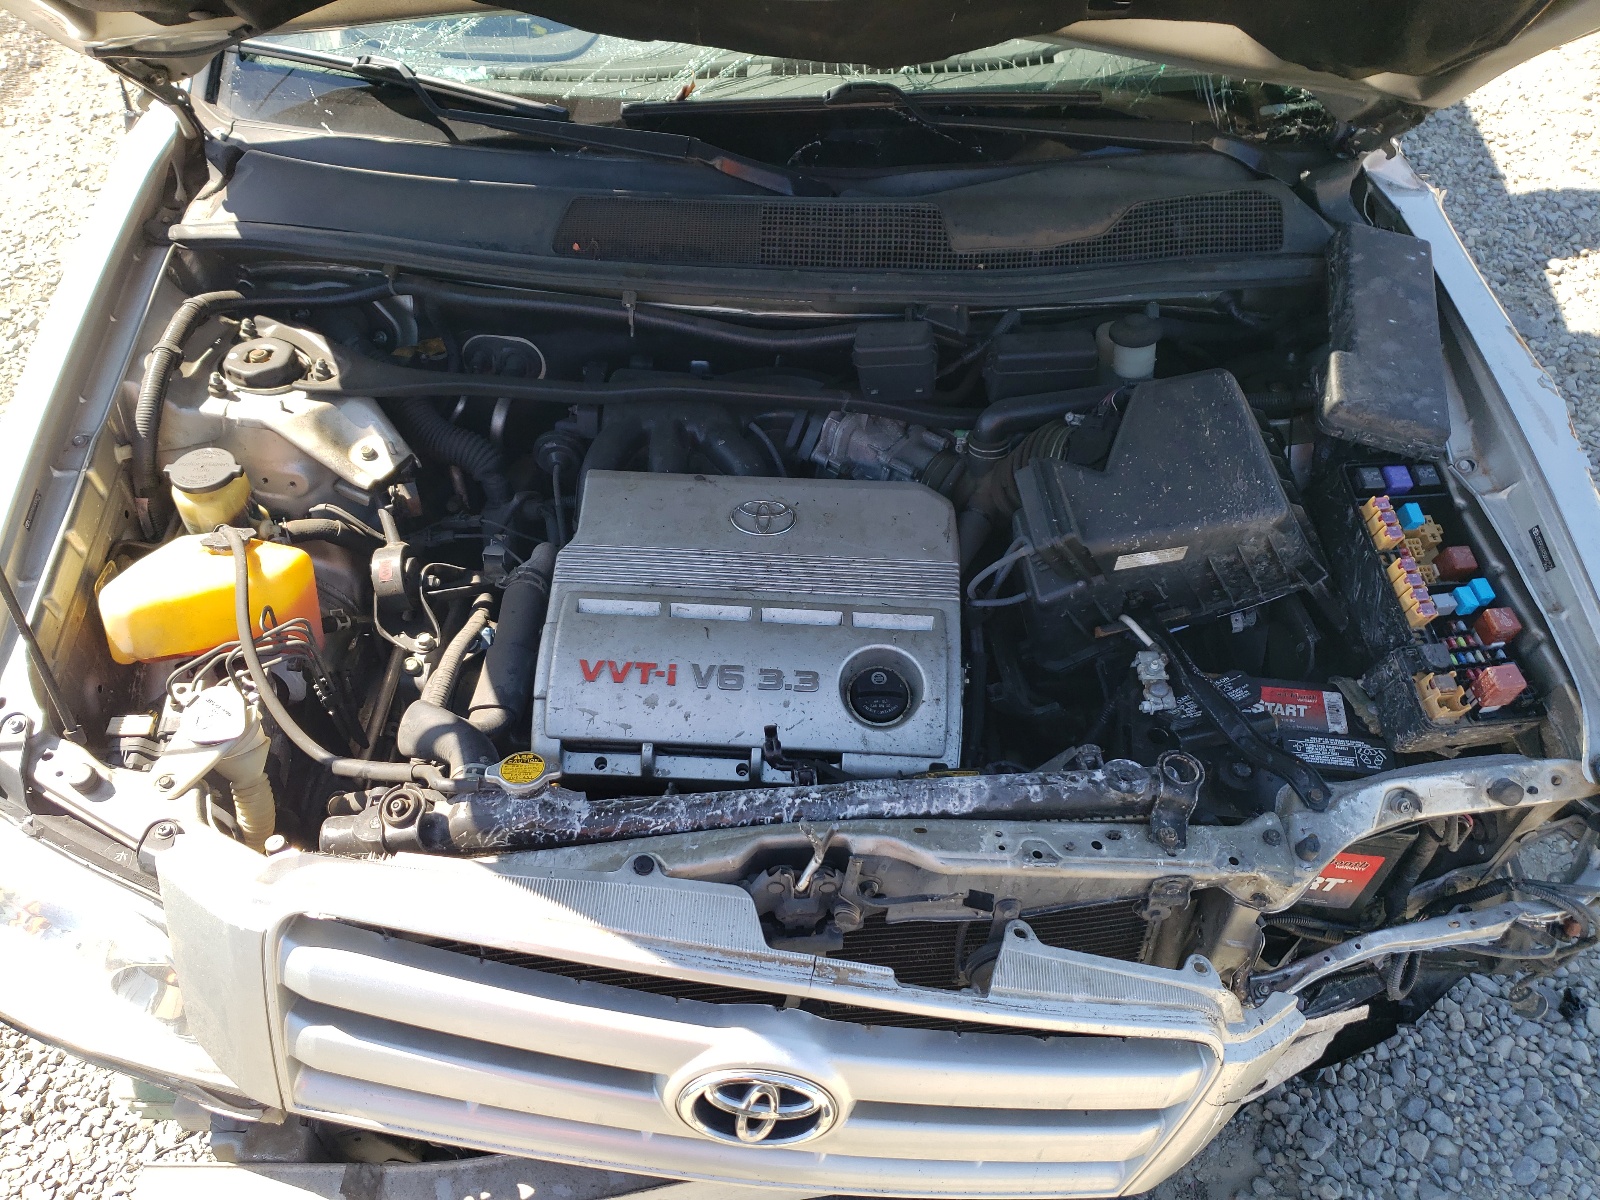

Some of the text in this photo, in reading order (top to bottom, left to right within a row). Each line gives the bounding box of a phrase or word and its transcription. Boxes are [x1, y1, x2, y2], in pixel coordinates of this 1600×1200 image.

[579, 658, 820, 693] VVT-i V6 3.3
[1242, 699, 1308, 718] START
